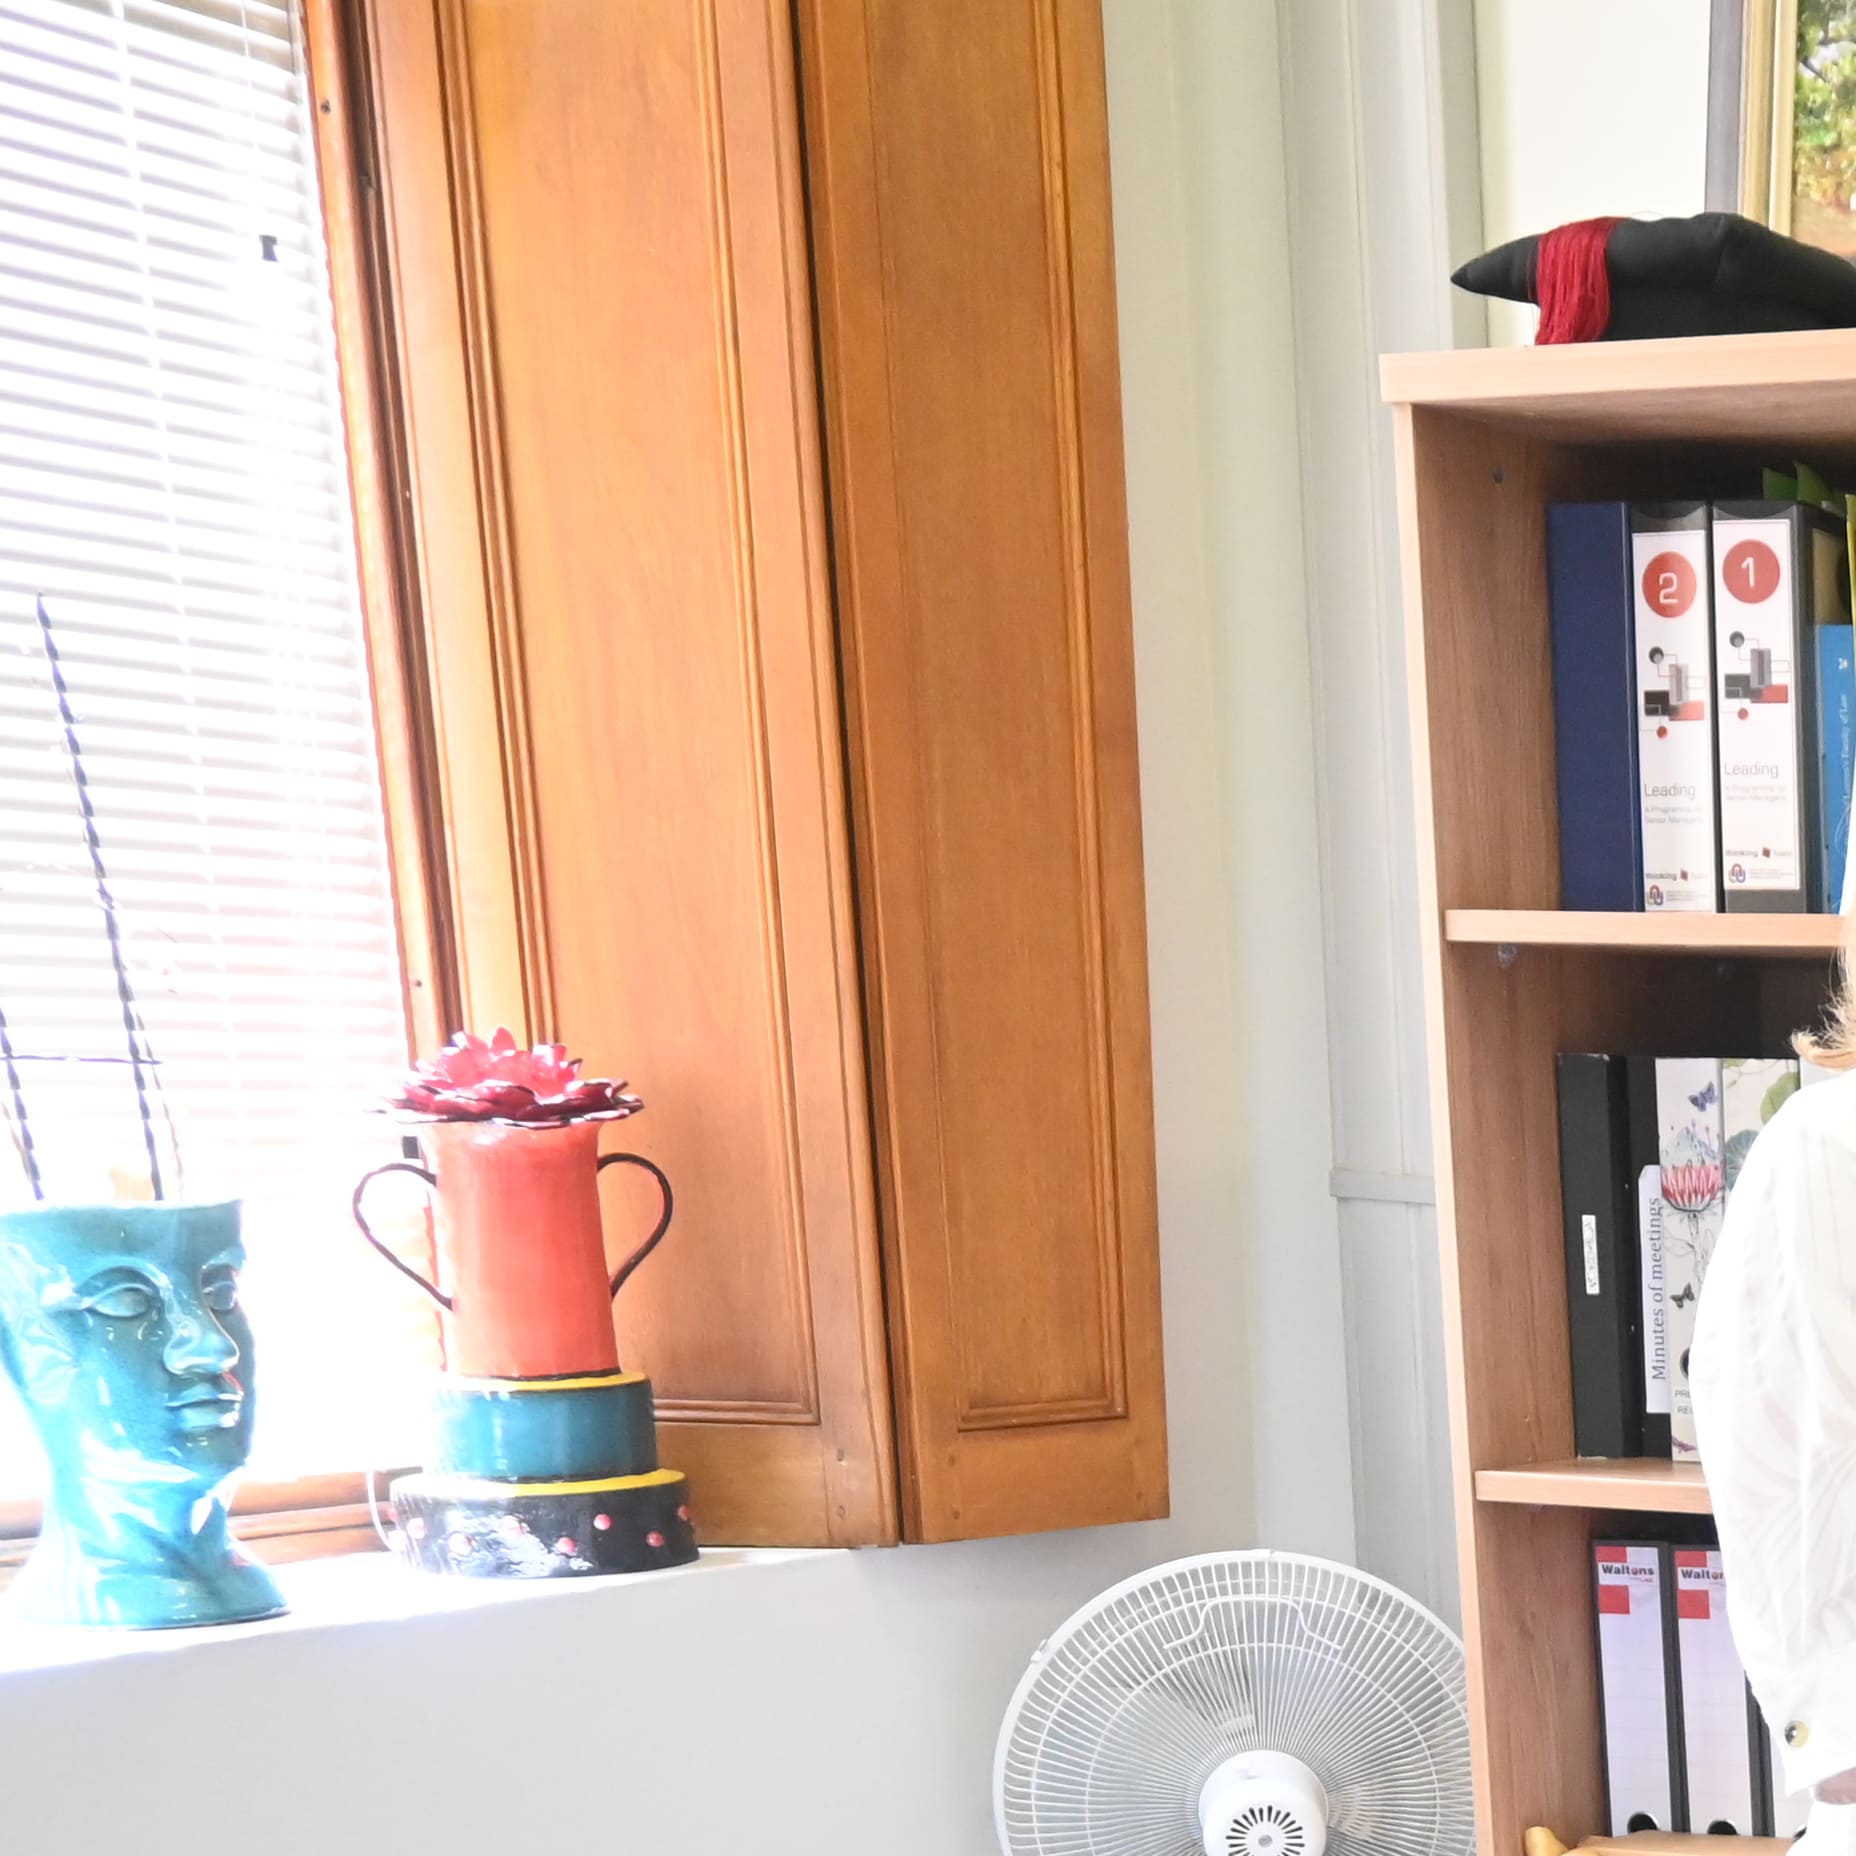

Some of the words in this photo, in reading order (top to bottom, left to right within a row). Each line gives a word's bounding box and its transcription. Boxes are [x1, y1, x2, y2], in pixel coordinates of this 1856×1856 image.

[1741, 557, 1755, 587] 1
[1659, 573, 1678, 603] 2
[1724, 762, 1779, 779] Leading
[1644, 784, 1695, 799] Leading
[1648, 1197, 1663, 1278] meetings
[1649, 1281, 1664, 1302] of
[1650, 1306, 1666, 1381] Minutes
[1602, 1564, 1654, 1576] Waltons
